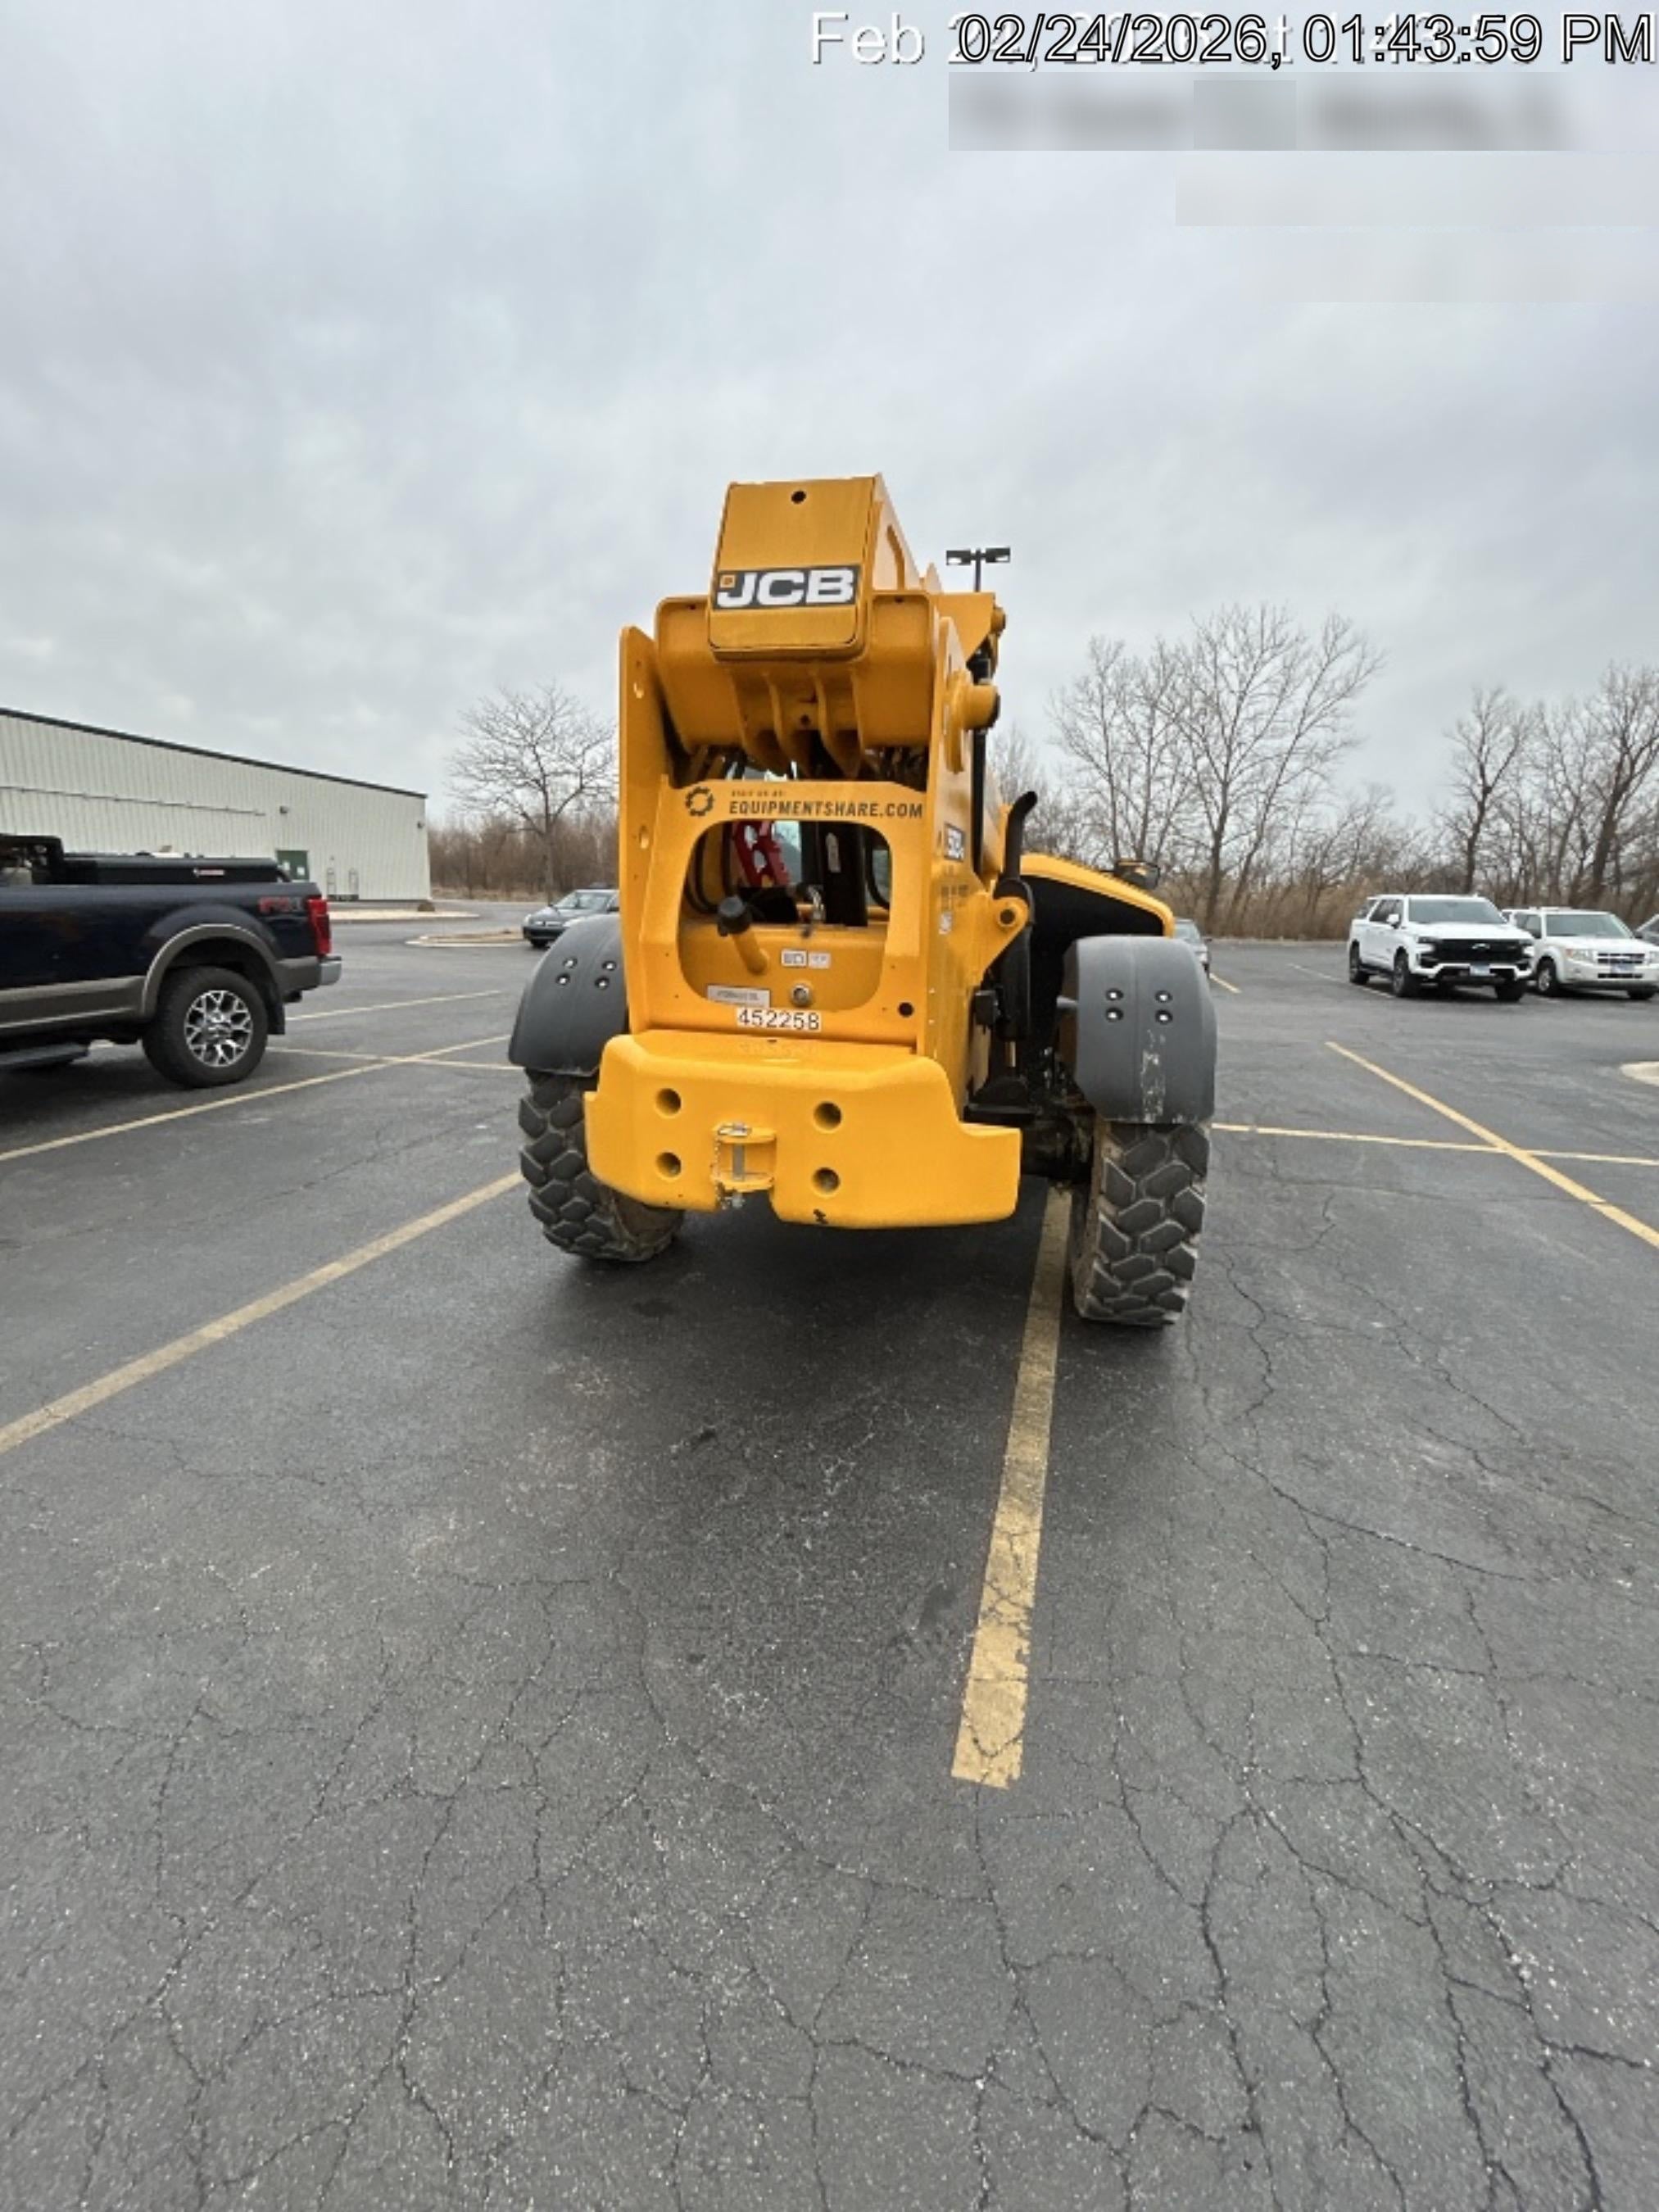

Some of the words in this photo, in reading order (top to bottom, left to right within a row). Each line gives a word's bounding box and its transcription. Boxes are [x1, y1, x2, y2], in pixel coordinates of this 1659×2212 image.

[717, 568, 854, 608] JCB
[729, 800, 923, 818] EQUIPMENTSHARE.COM
[739, 1009, 819, 1031] 452258
